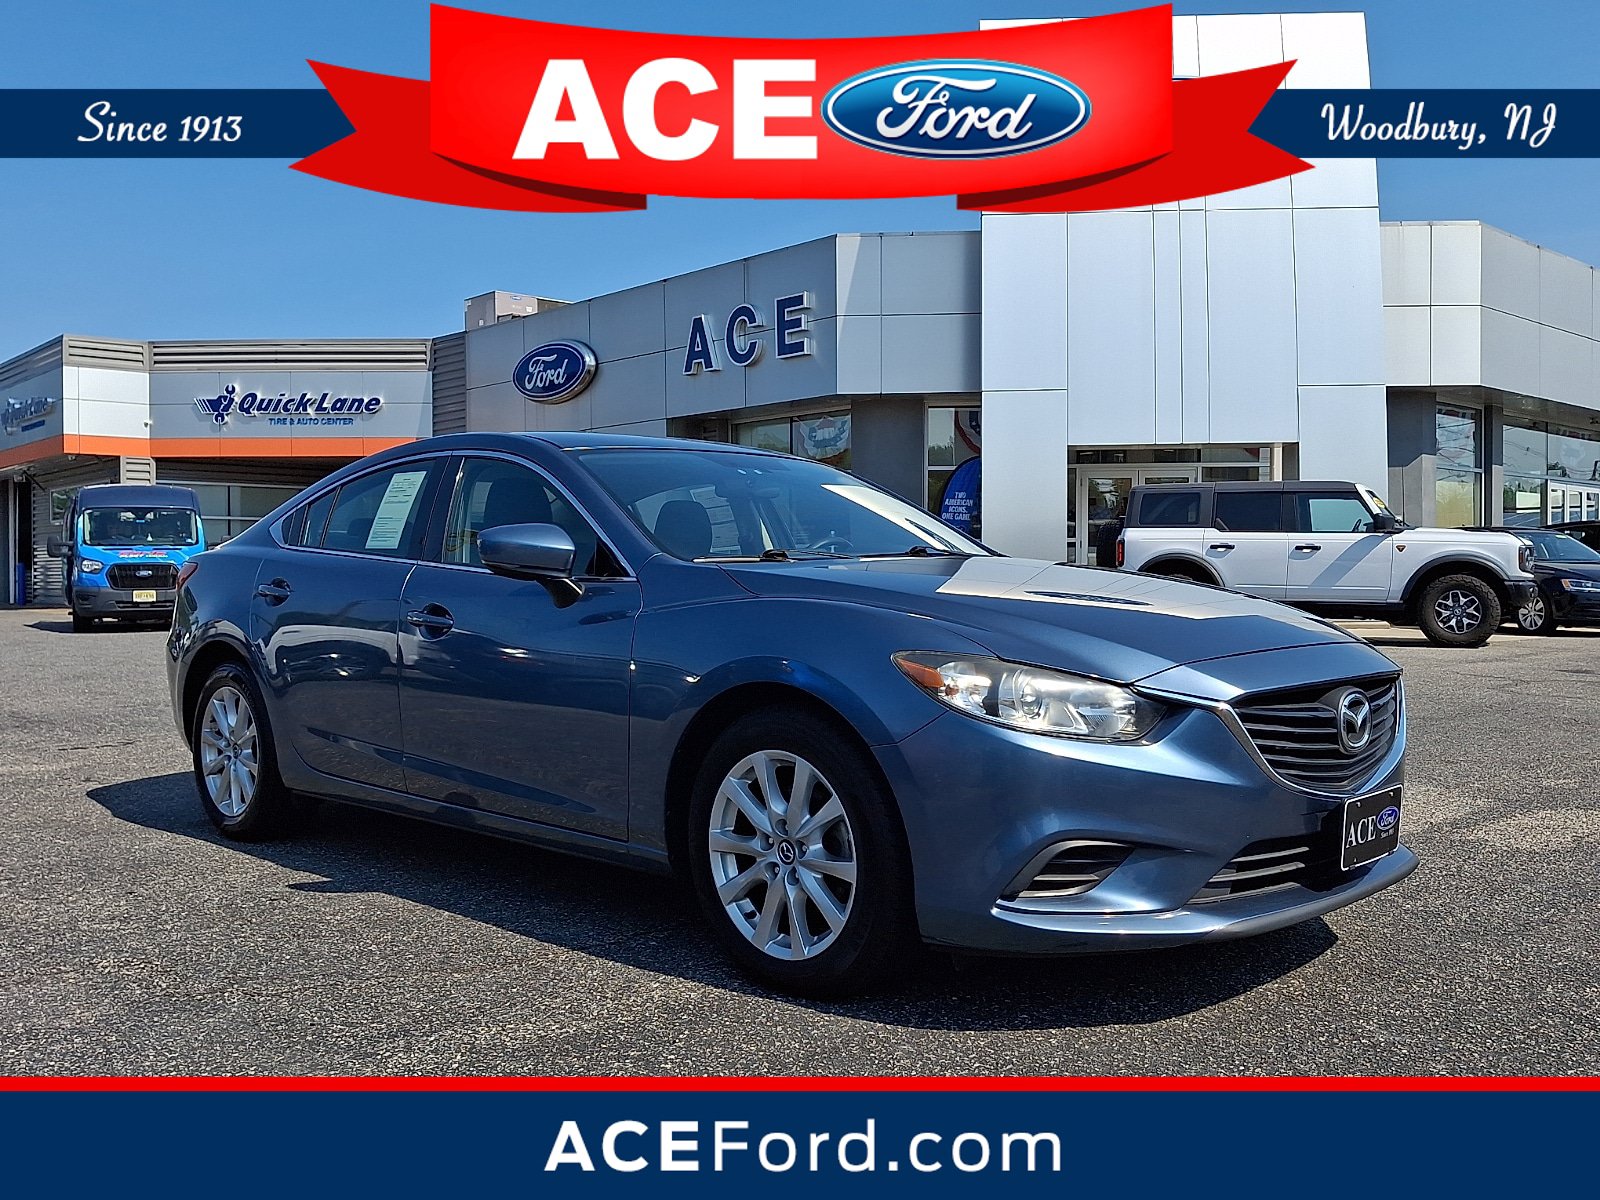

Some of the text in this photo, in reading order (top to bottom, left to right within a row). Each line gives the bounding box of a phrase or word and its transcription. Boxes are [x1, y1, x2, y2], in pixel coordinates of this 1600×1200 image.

[683, 290, 811, 375] ACE
[525, 354, 569, 390] Ford
[268, 418, 288, 426] TIRE
[296, 418, 318, 426] AUTO
[320, 418, 354, 426] CENTER
[1346, 811, 1396, 848] ACE Ford
